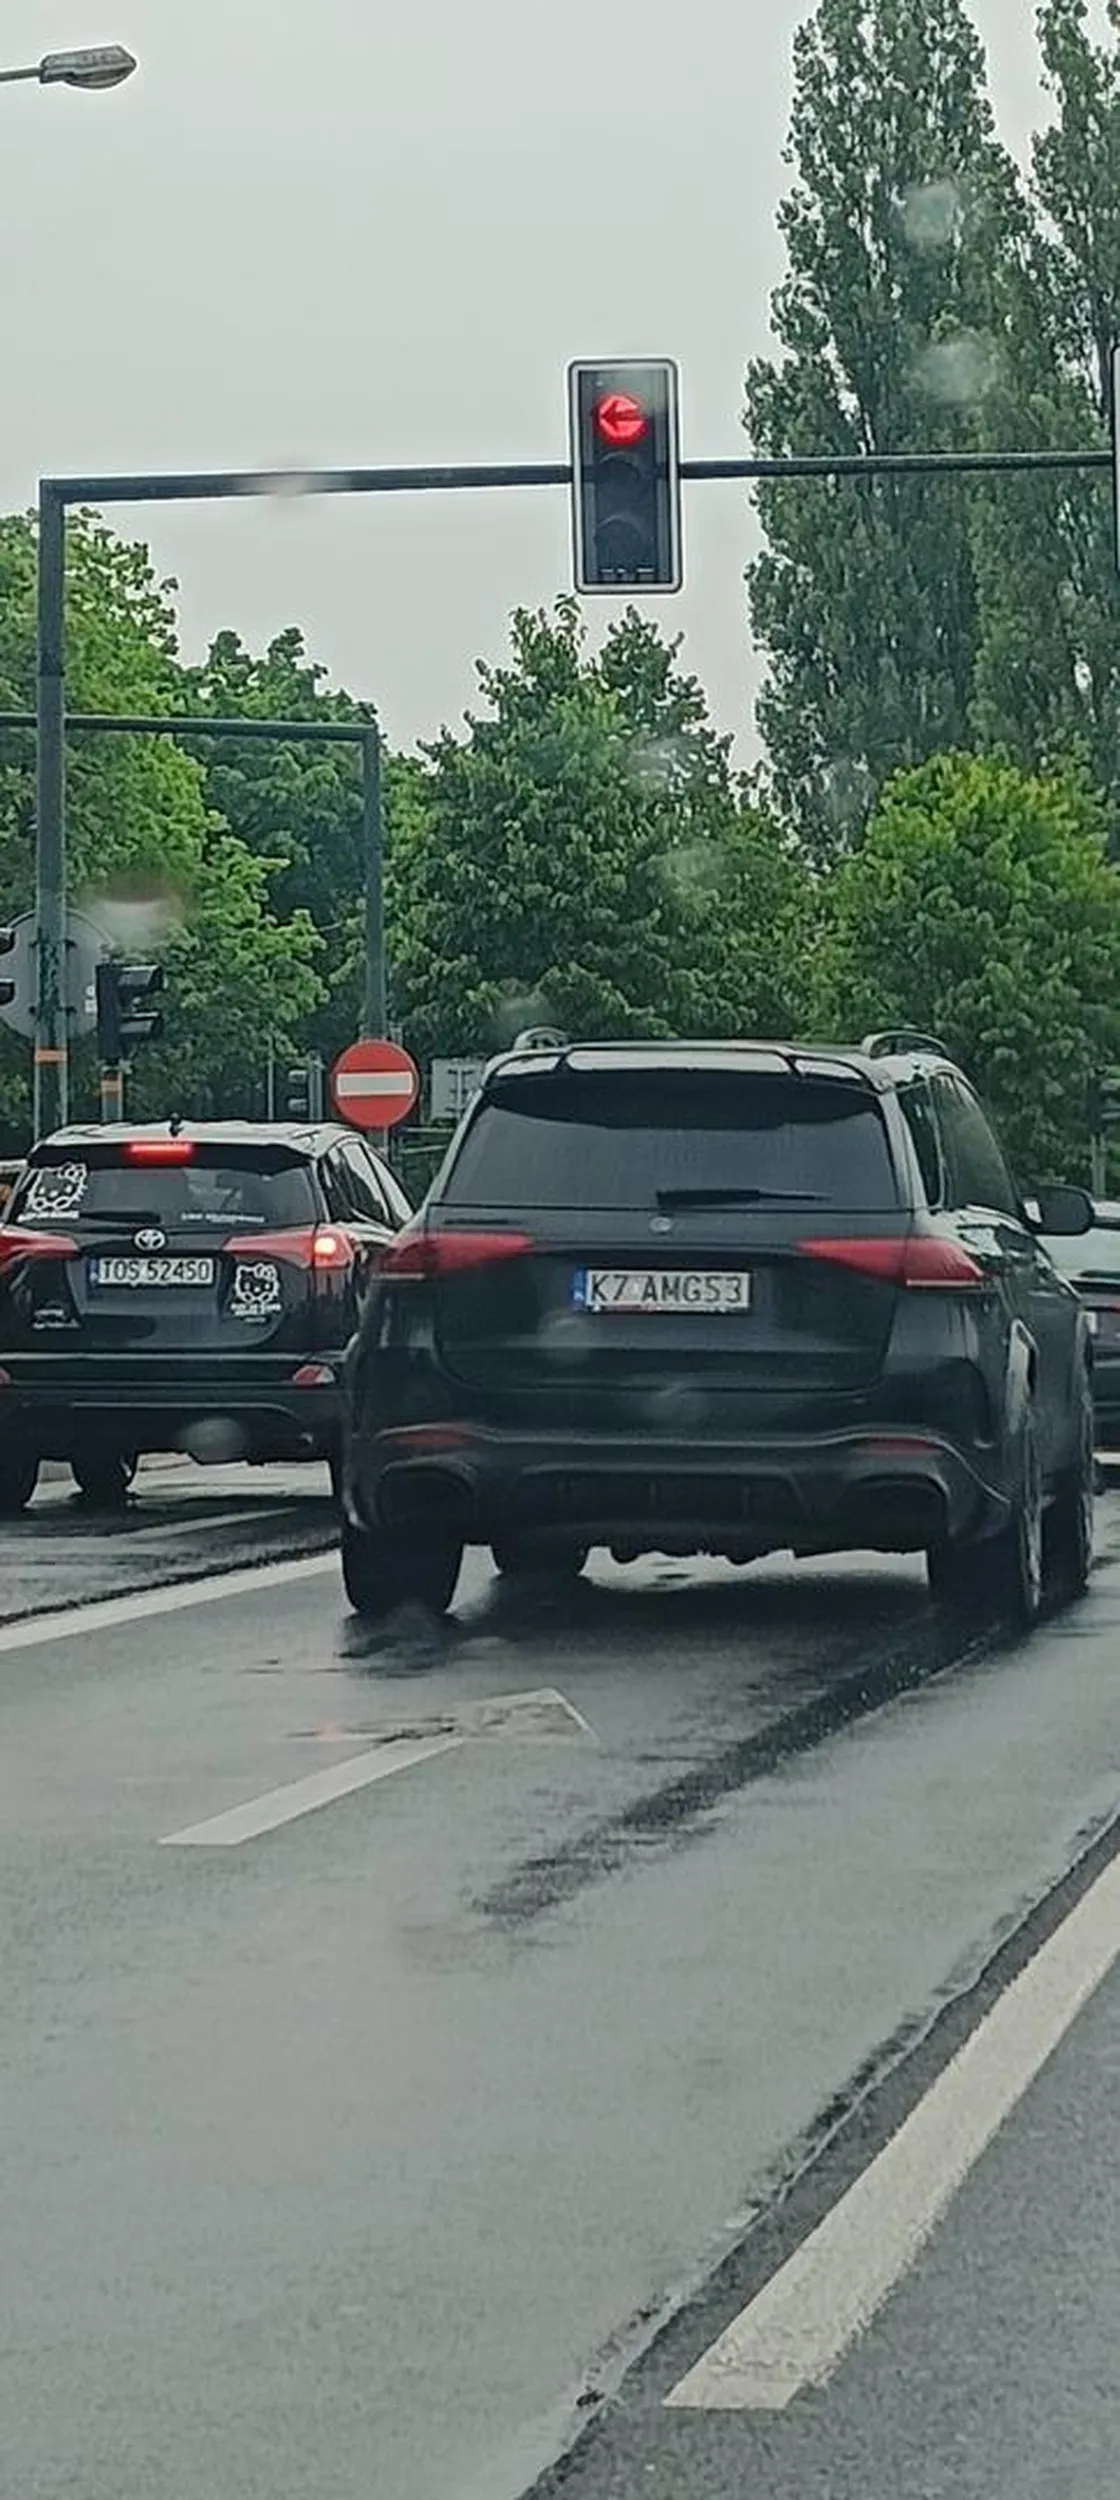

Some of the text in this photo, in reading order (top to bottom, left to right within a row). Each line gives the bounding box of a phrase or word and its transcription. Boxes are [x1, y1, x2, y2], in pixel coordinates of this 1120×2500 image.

[103, 1259, 140, 1281] TOS
[147, 1259, 210, 1281] 52450
[591, 1273, 628, 1302] K7
[641, 1274, 742, 1303] AMG53
